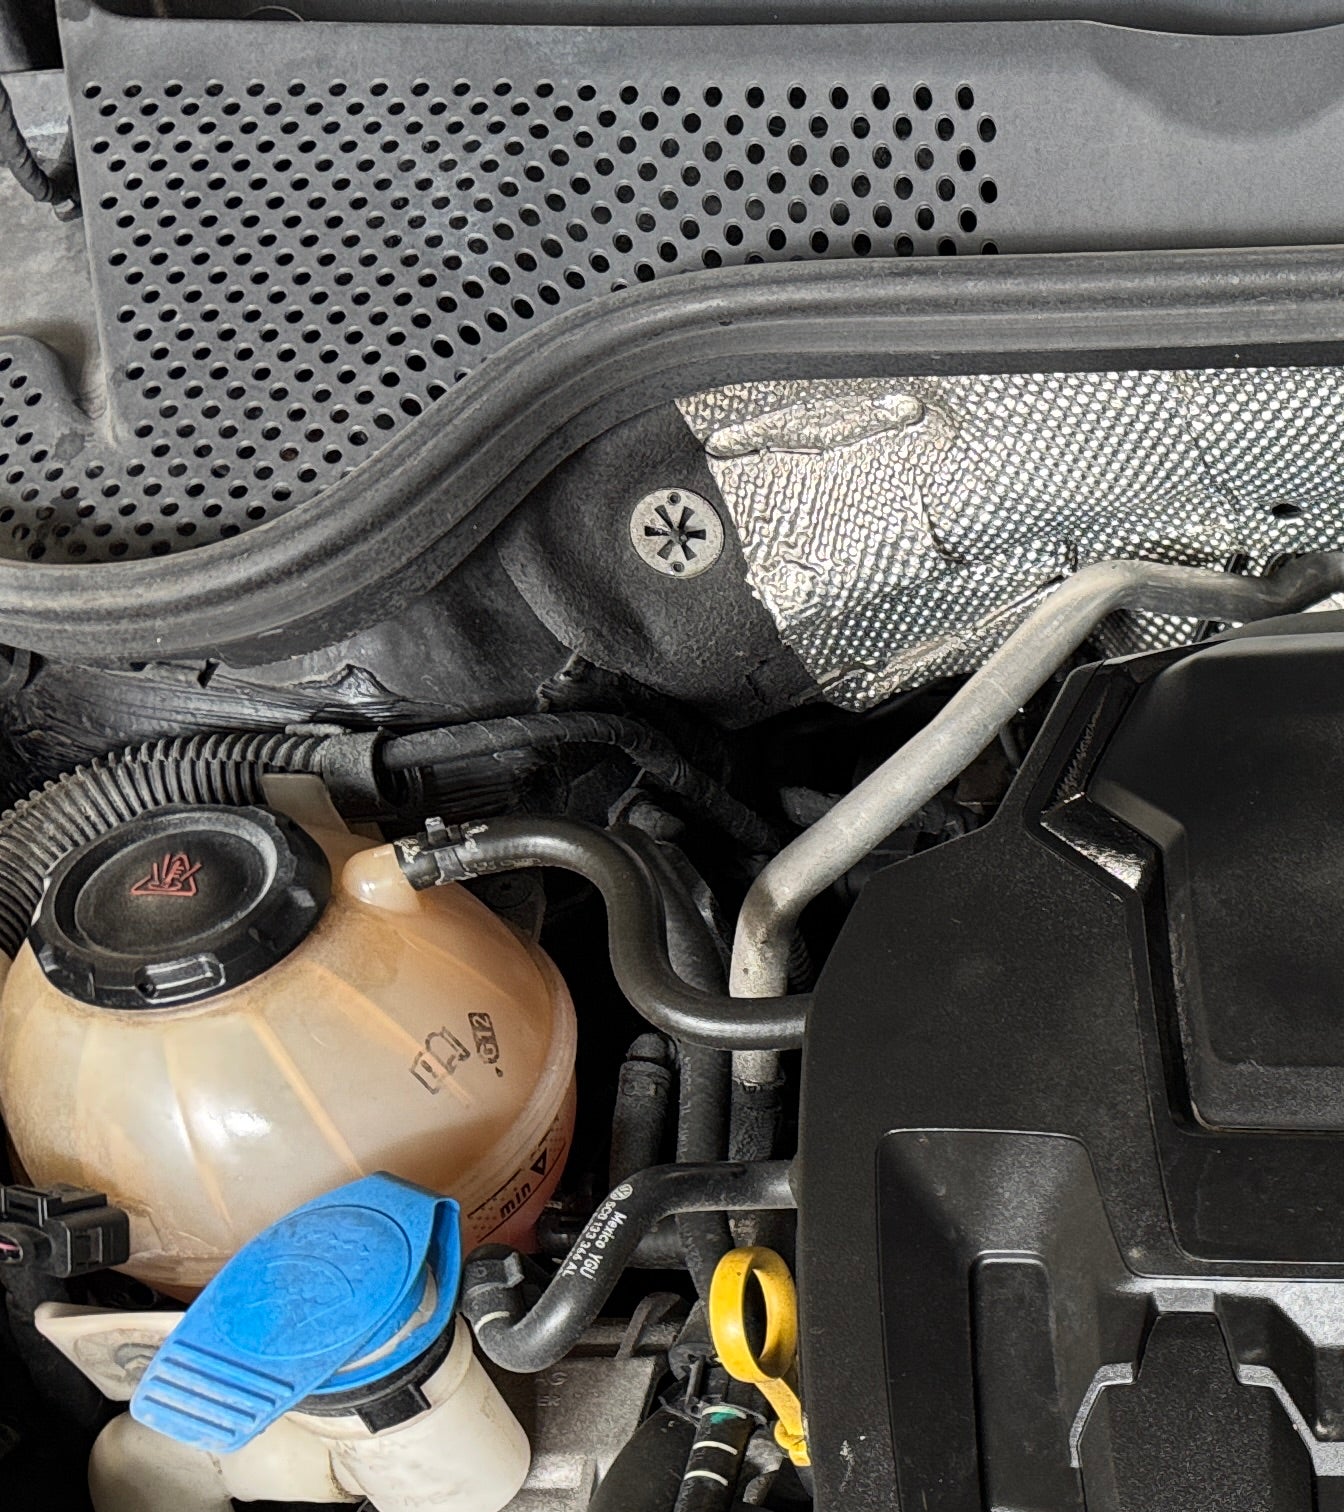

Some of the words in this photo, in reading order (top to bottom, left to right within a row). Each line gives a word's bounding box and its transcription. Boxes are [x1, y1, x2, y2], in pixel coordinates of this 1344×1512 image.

[472, 1014, 498, 1062] G12
[499, 1182, 531, 1219] min
[585, 1222, 603, 1240] 133
[595, 1211, 627, 1249] Mexico
[562, 1262, 578, 1277] AL
